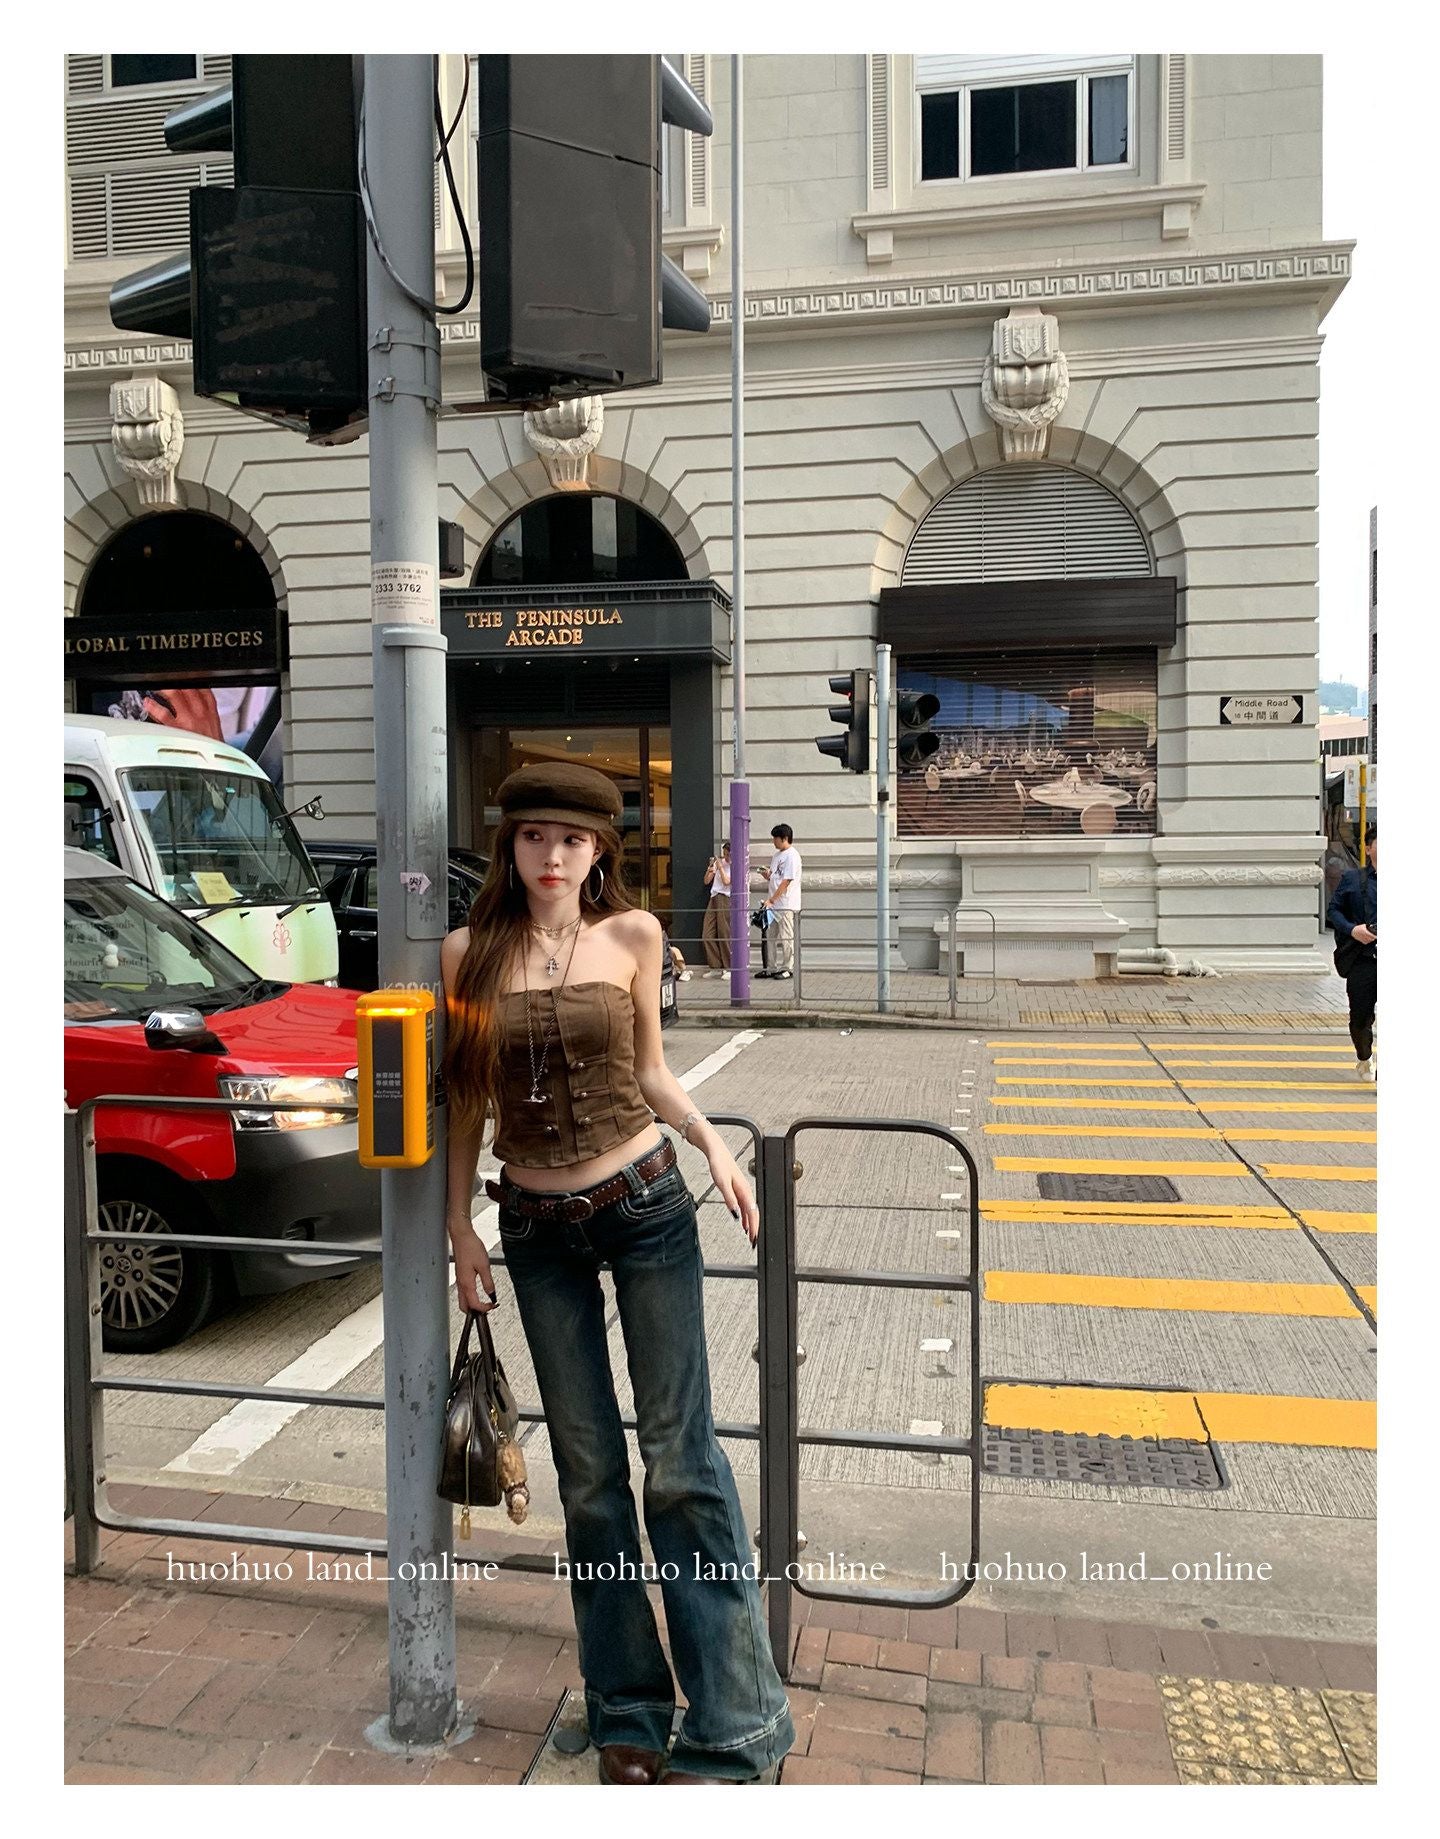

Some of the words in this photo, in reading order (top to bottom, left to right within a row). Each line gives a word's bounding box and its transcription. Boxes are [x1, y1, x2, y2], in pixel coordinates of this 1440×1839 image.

[397, 583, 422, 594] 3762
[465, 612, 503, 628] THE
[516, 608, 623, 627] PENINSULA
[136, 630, 264, 650] TIMEPIECES
[506, 628, 584, 647] ARCADE
[1266, 699, 1289, 707] Road
[1243, 710, 1279, 720] 中間道
